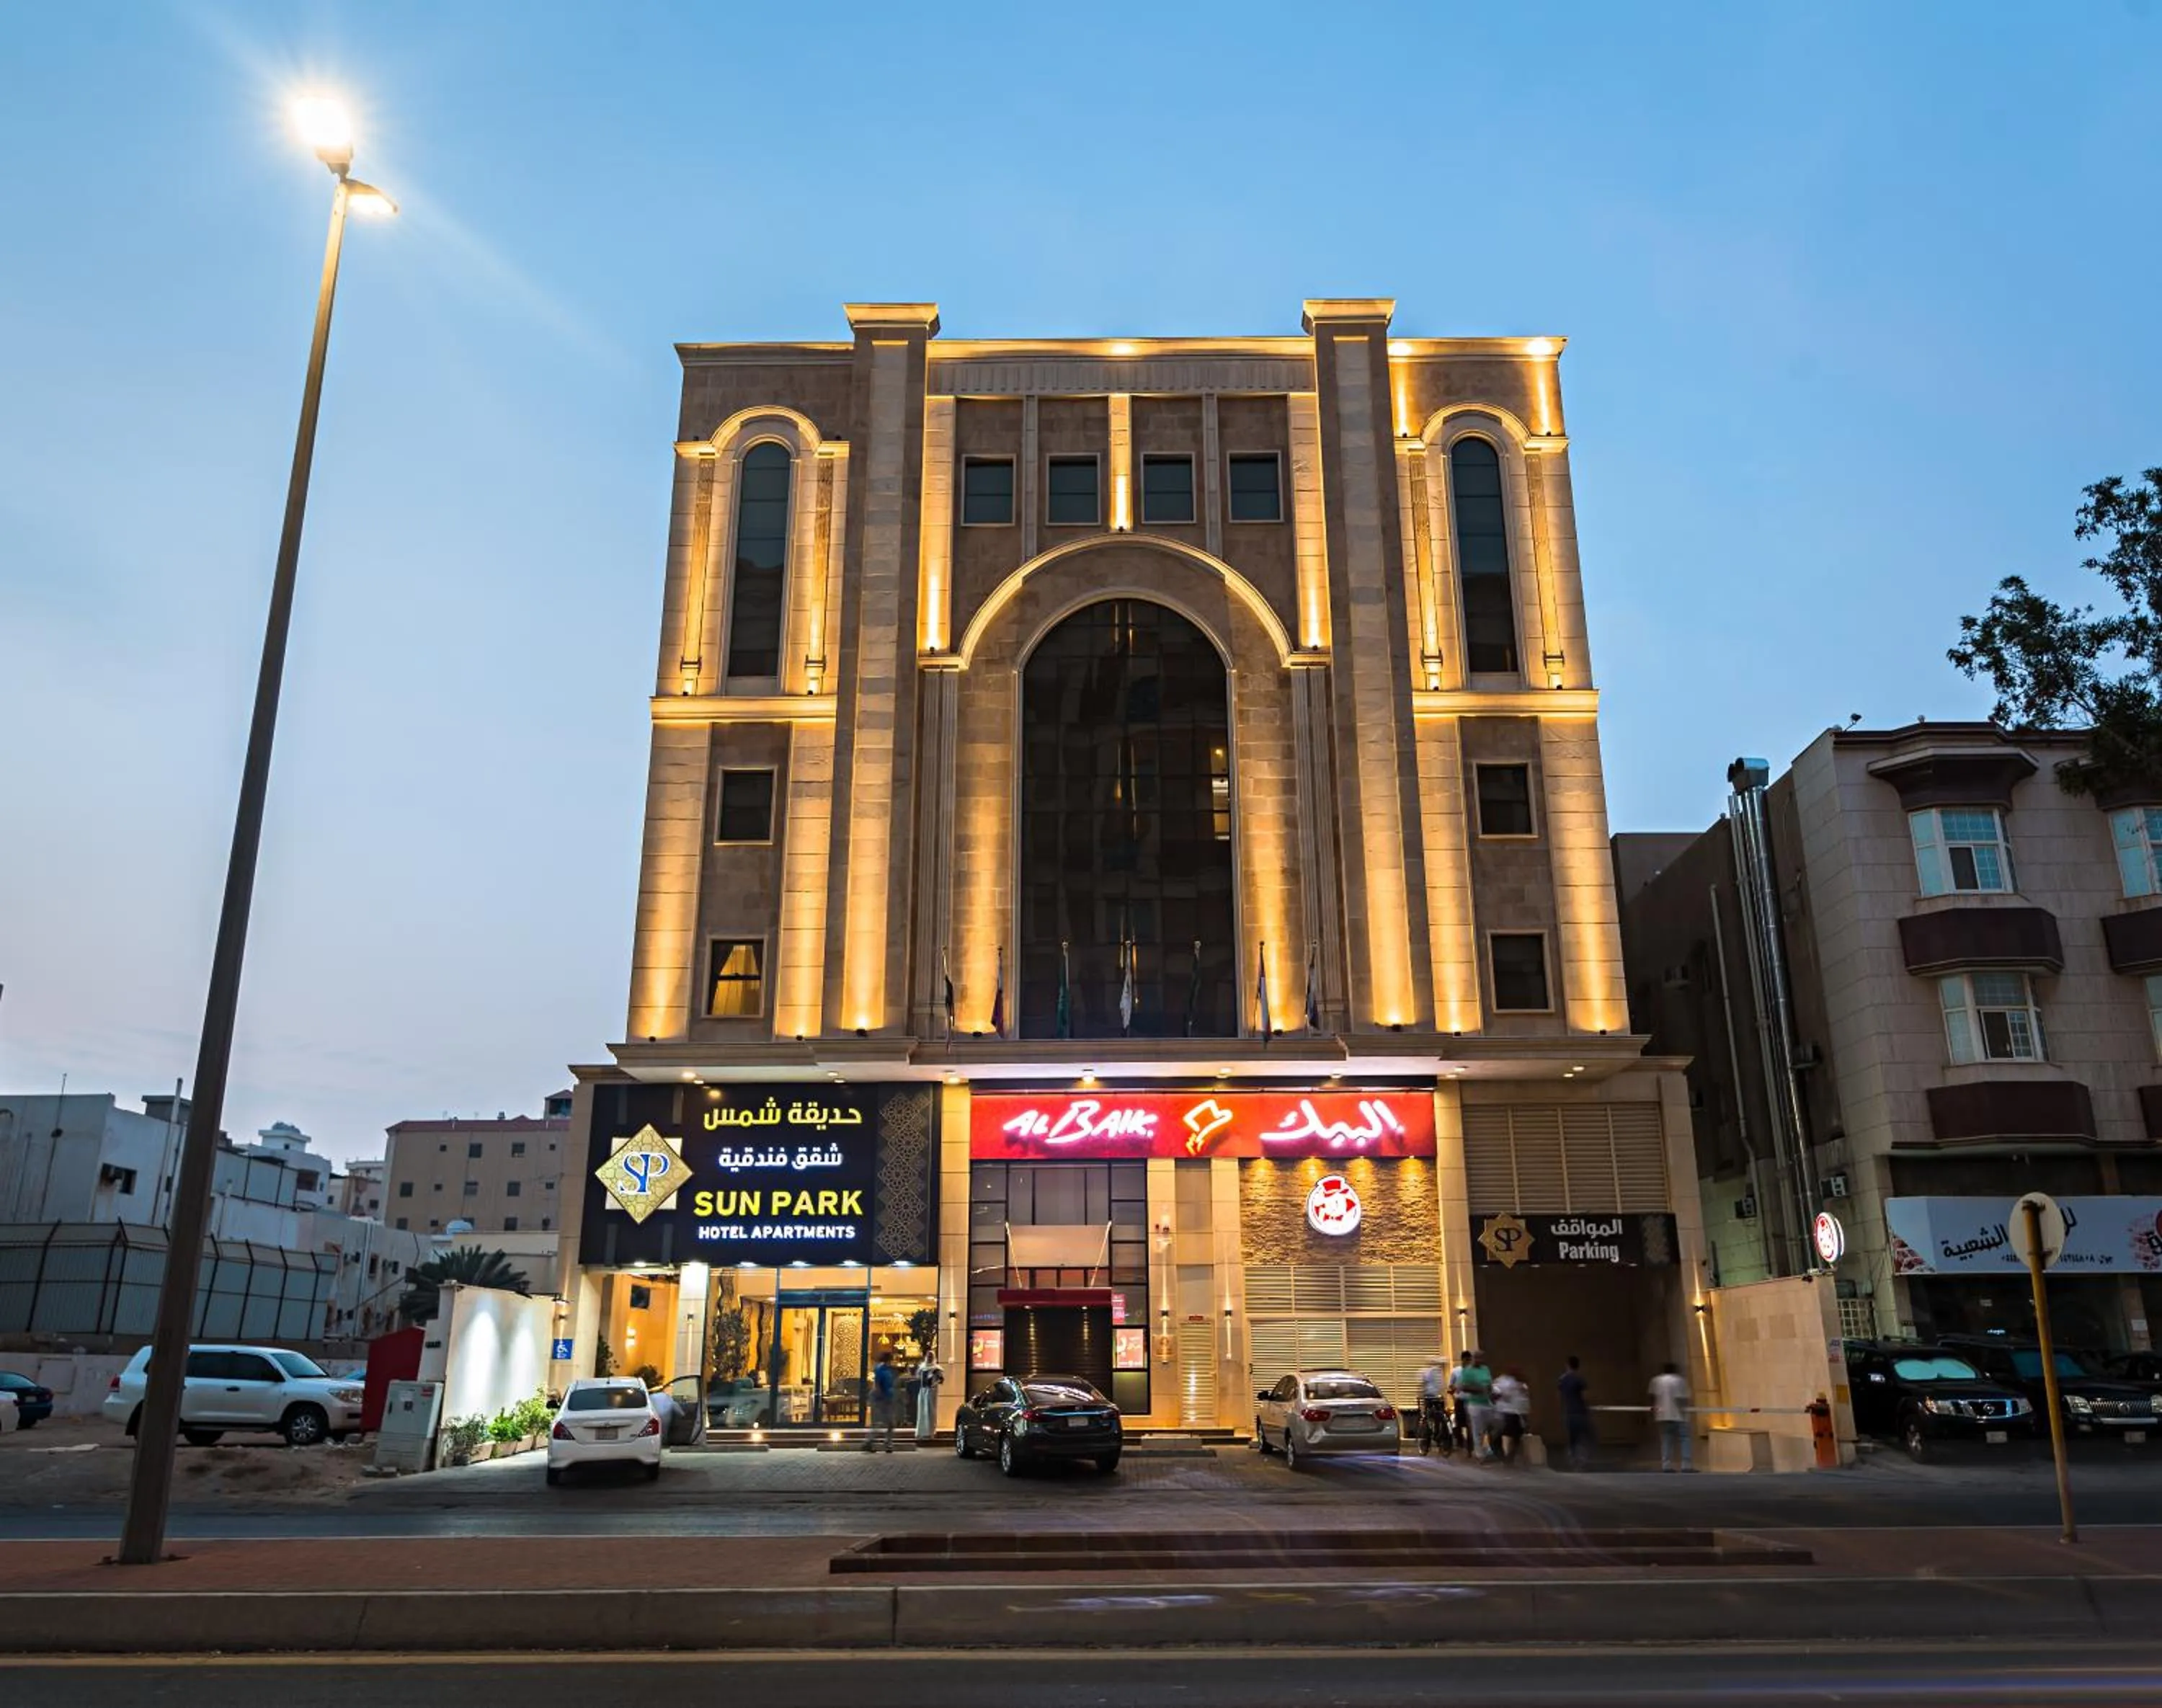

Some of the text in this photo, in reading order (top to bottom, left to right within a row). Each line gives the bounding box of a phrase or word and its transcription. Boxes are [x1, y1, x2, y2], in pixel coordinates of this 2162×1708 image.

[703, 1096, 863, 1131] حديقة شمس
[1259, 1099, 1405, 1147] البيك
[718, 1143, 842, 1173] شقق فندقية
[693, 1190, 864, 1217] SUN PARK
[698, 1225, 856, 1240] HOTEL APARTMENTS
[1550, 1219, 1624, 1237] المواقف
[1559, 1241, 1620, 1263] Parking
